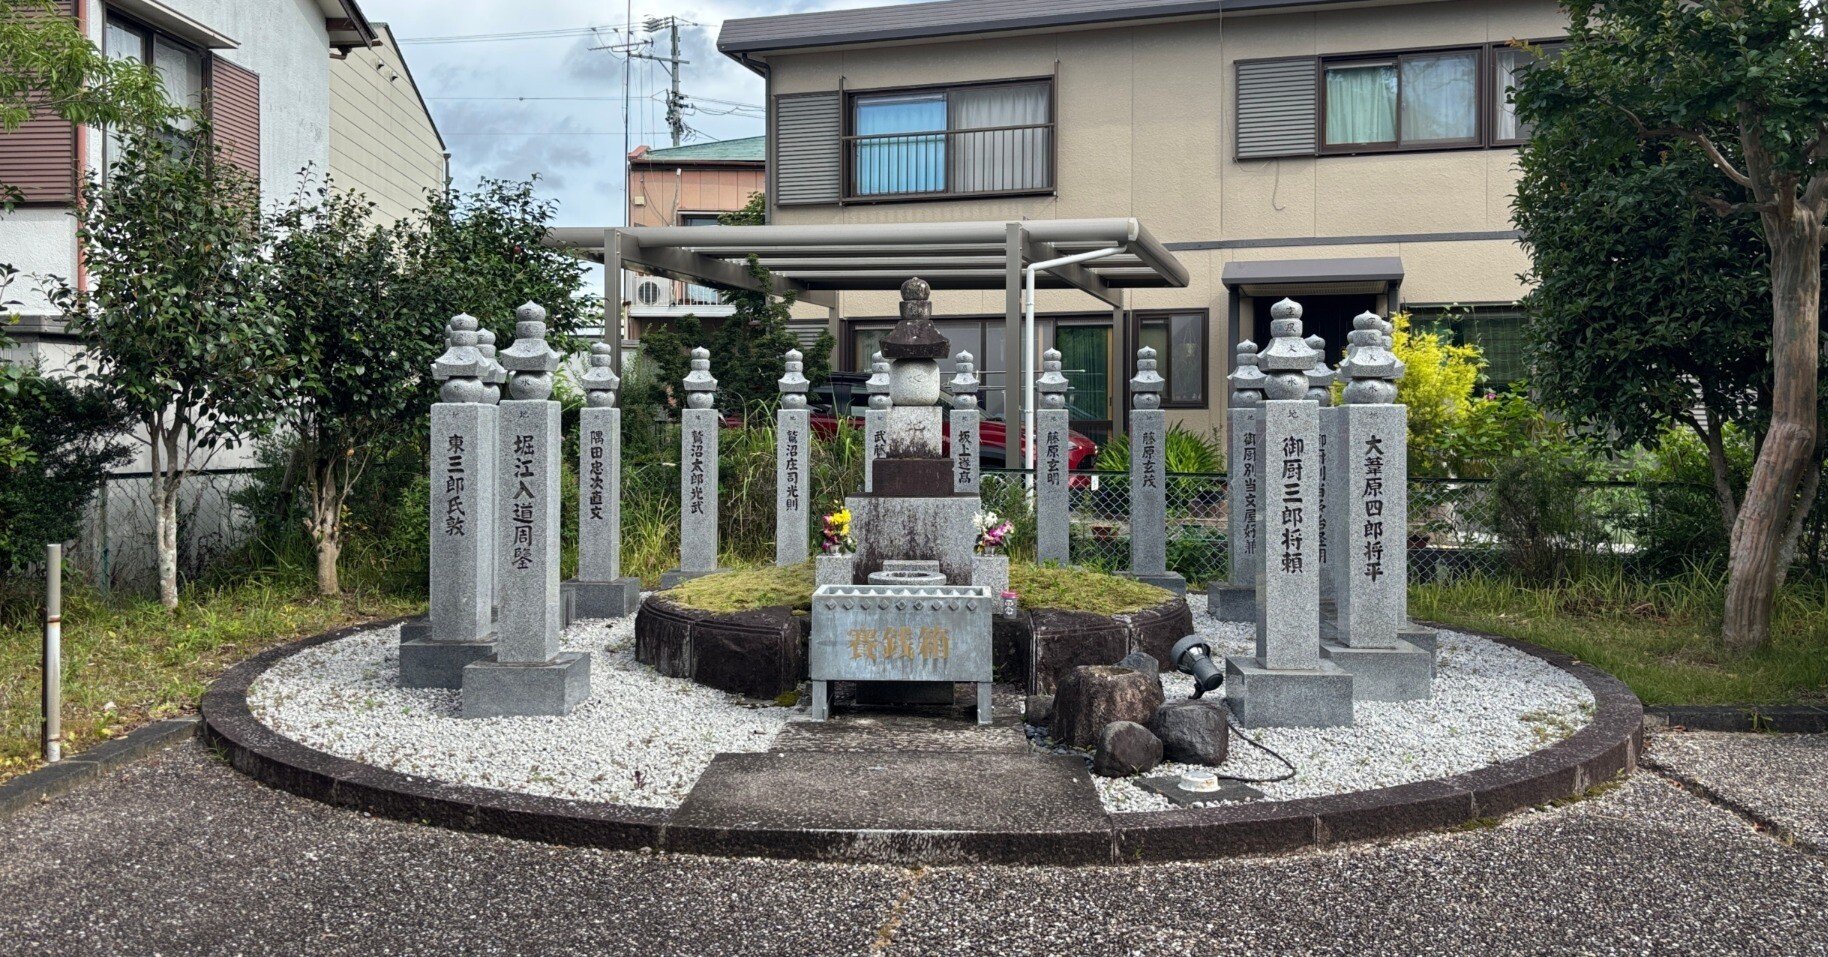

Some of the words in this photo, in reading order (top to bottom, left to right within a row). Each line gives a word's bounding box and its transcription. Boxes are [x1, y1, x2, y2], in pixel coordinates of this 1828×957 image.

[446, 433, 466, 537] 東三郎氏敦
[590, 430, 604, 520] 隅田忠次直文
[1046, 431, 1060, 486] 藤原玄明
[1142, 431, 1156, 489] 藤原玄茂
[1281, 435, 1304, 573] 御厨三郎将頼
[1362, 434, 1384, 583] 大葦原四郎将平
